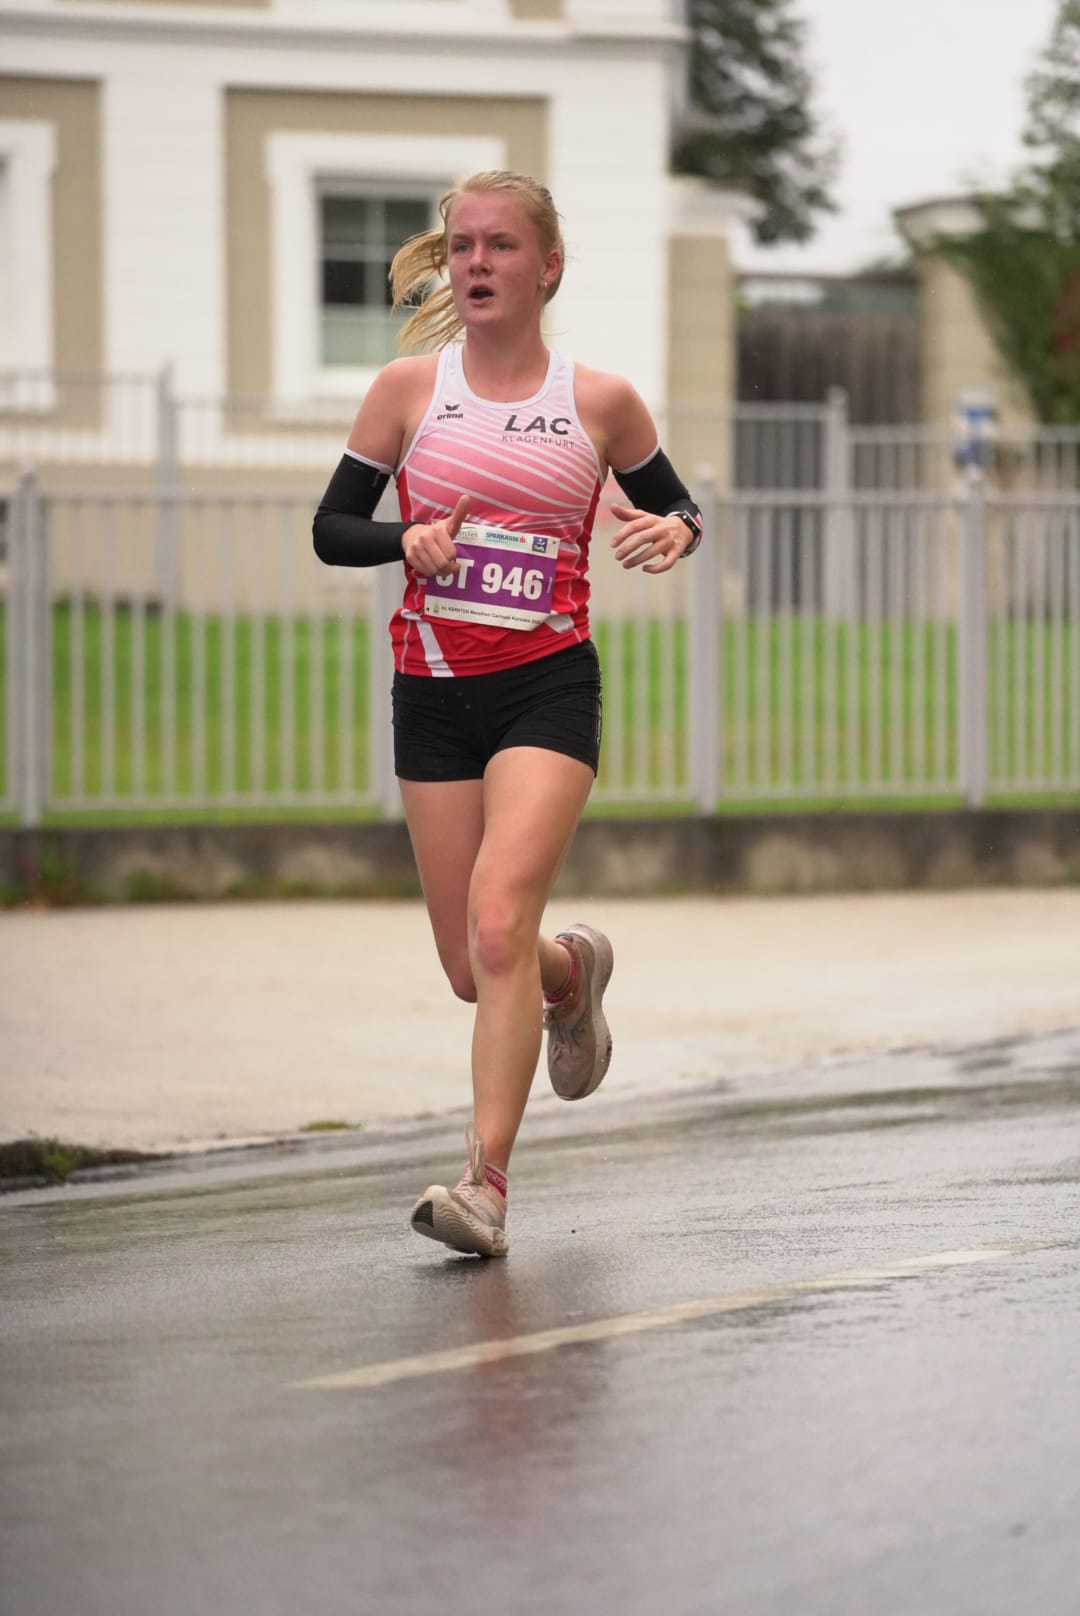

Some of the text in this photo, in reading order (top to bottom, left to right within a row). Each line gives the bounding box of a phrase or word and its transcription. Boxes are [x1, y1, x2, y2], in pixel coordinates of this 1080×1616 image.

[504, 414, 571, 435] LAC
[502, 435, 575, 449] KLAGENFURT
[486, 532, 519, 542] SPARKASSE
[481, 562, 544, 600] 946
